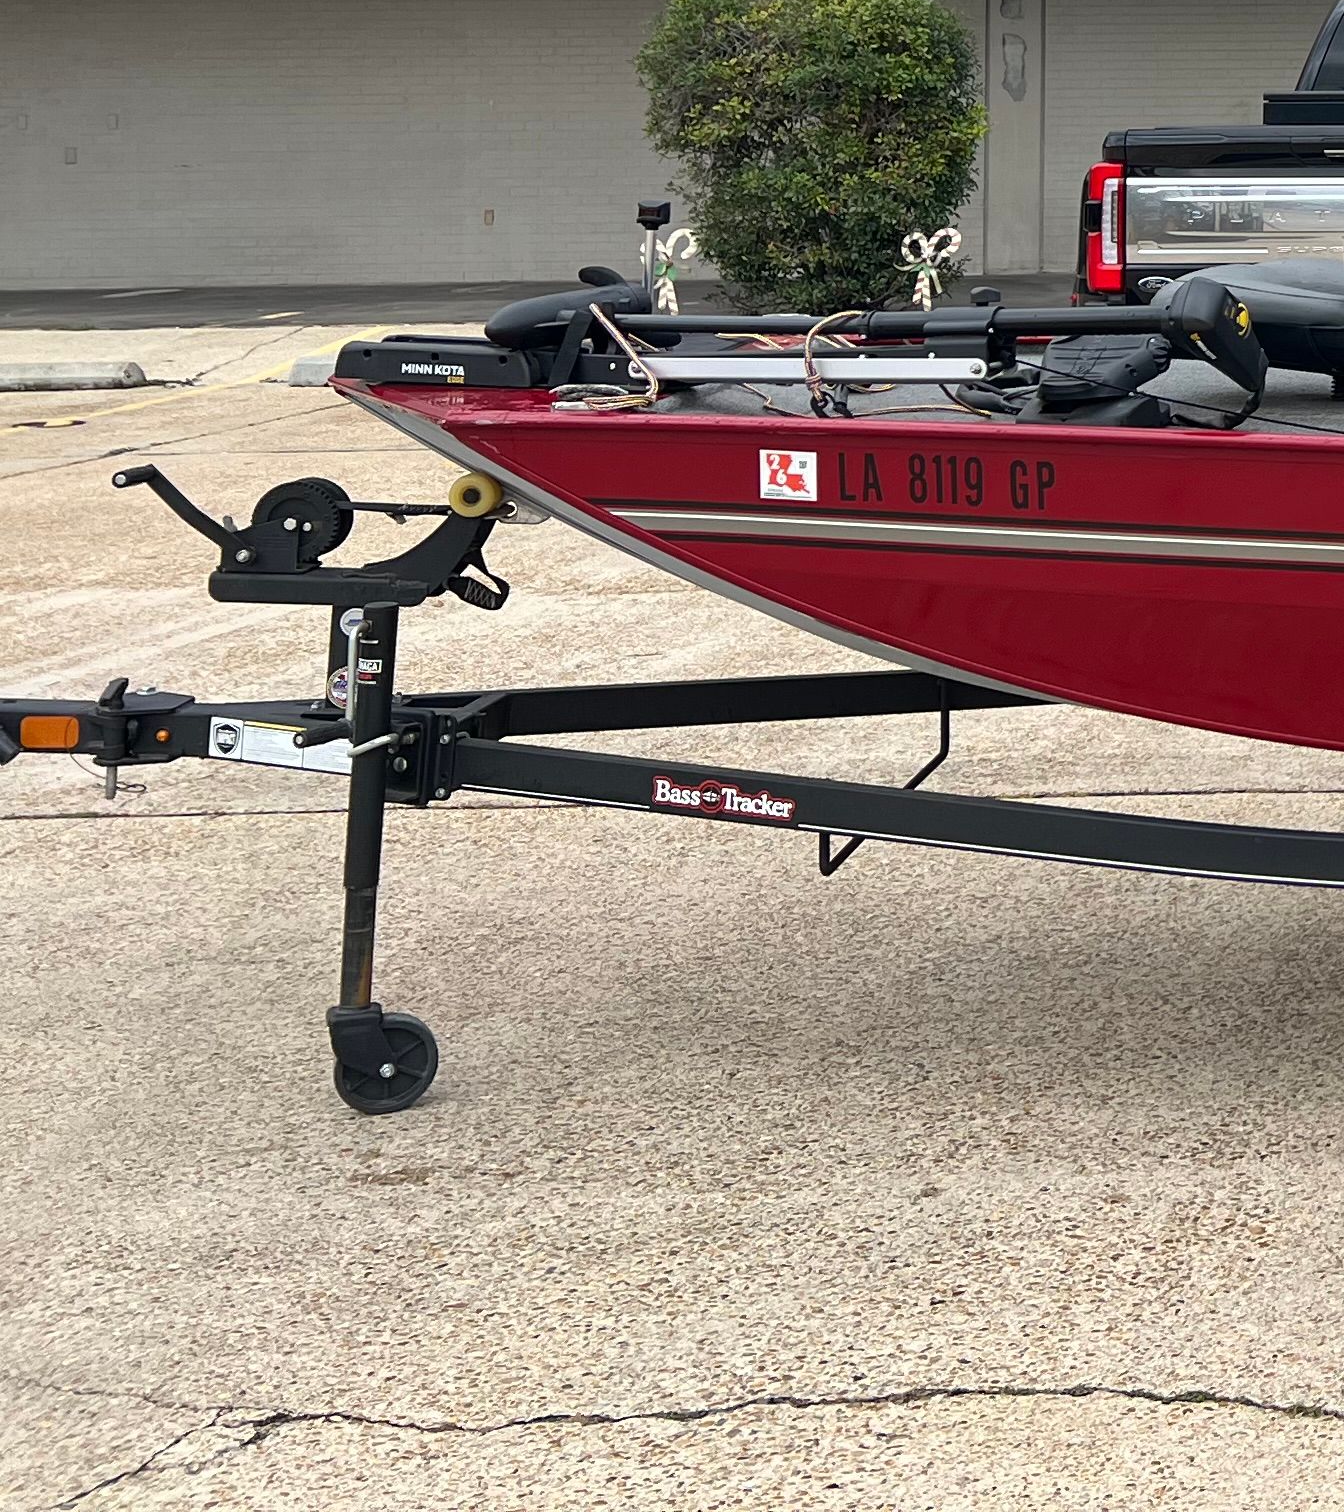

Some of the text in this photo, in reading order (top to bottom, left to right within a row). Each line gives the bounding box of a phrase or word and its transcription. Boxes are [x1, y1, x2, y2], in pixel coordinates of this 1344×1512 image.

[401, 362, 465, 376] MINN KOTA
[837, 452, 1056, 510] LA 8119 GP
[655, 779, 793, 818] Bass Tracker
